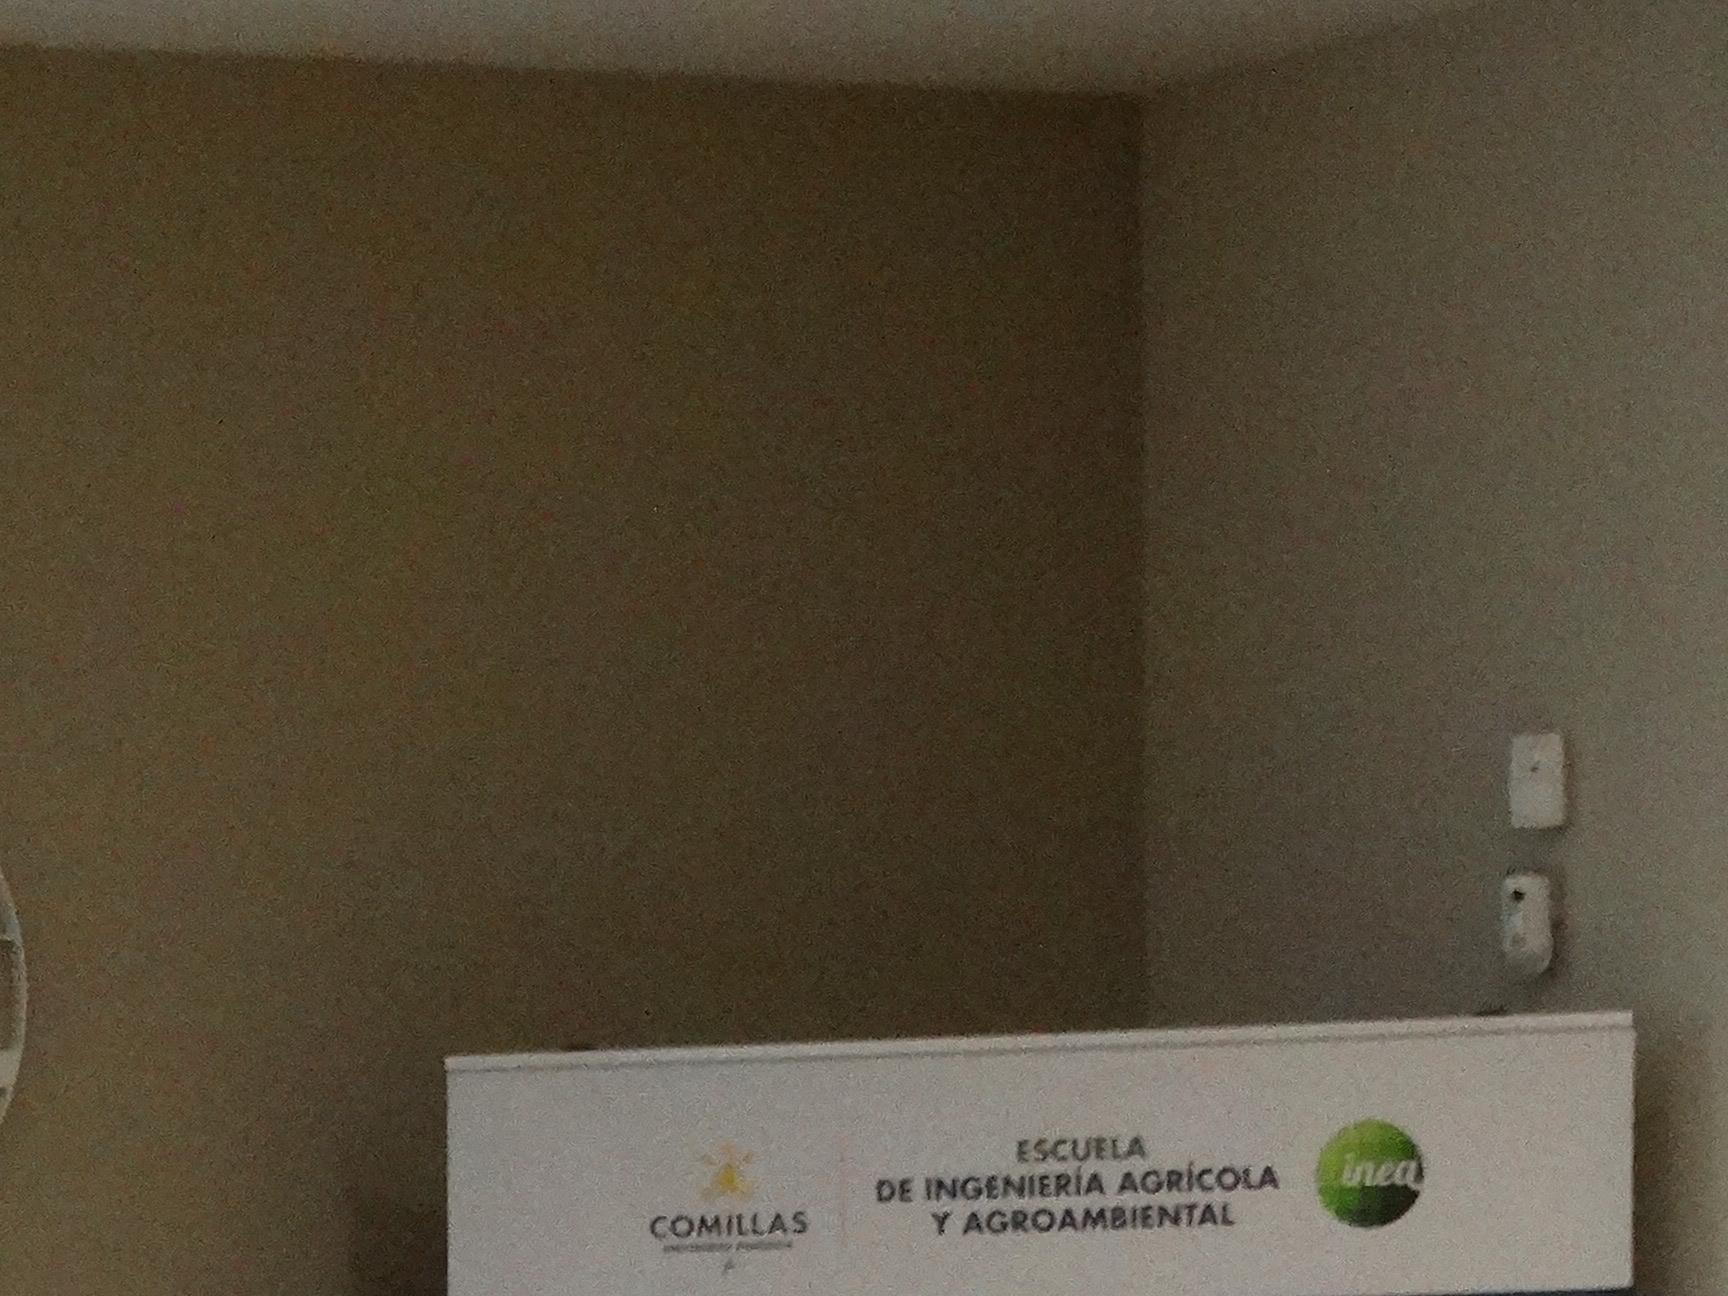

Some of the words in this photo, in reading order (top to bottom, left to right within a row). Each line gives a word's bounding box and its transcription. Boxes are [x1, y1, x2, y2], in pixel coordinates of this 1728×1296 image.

[1016, 1135, 1147, 1164] ESCUELA
[875, 1178, 912, 1203] DE
[925, 1171, 1105, 1201] INGENIERÍA
[1116, 1161, 1280, 1196] AGRÍCOLA
[649, 1210, 808, 1239] COMILLAS
[931, 1211, 951, 1235] Y
[962, 1202, 1235, 1235] AGROAMBIENTAL
